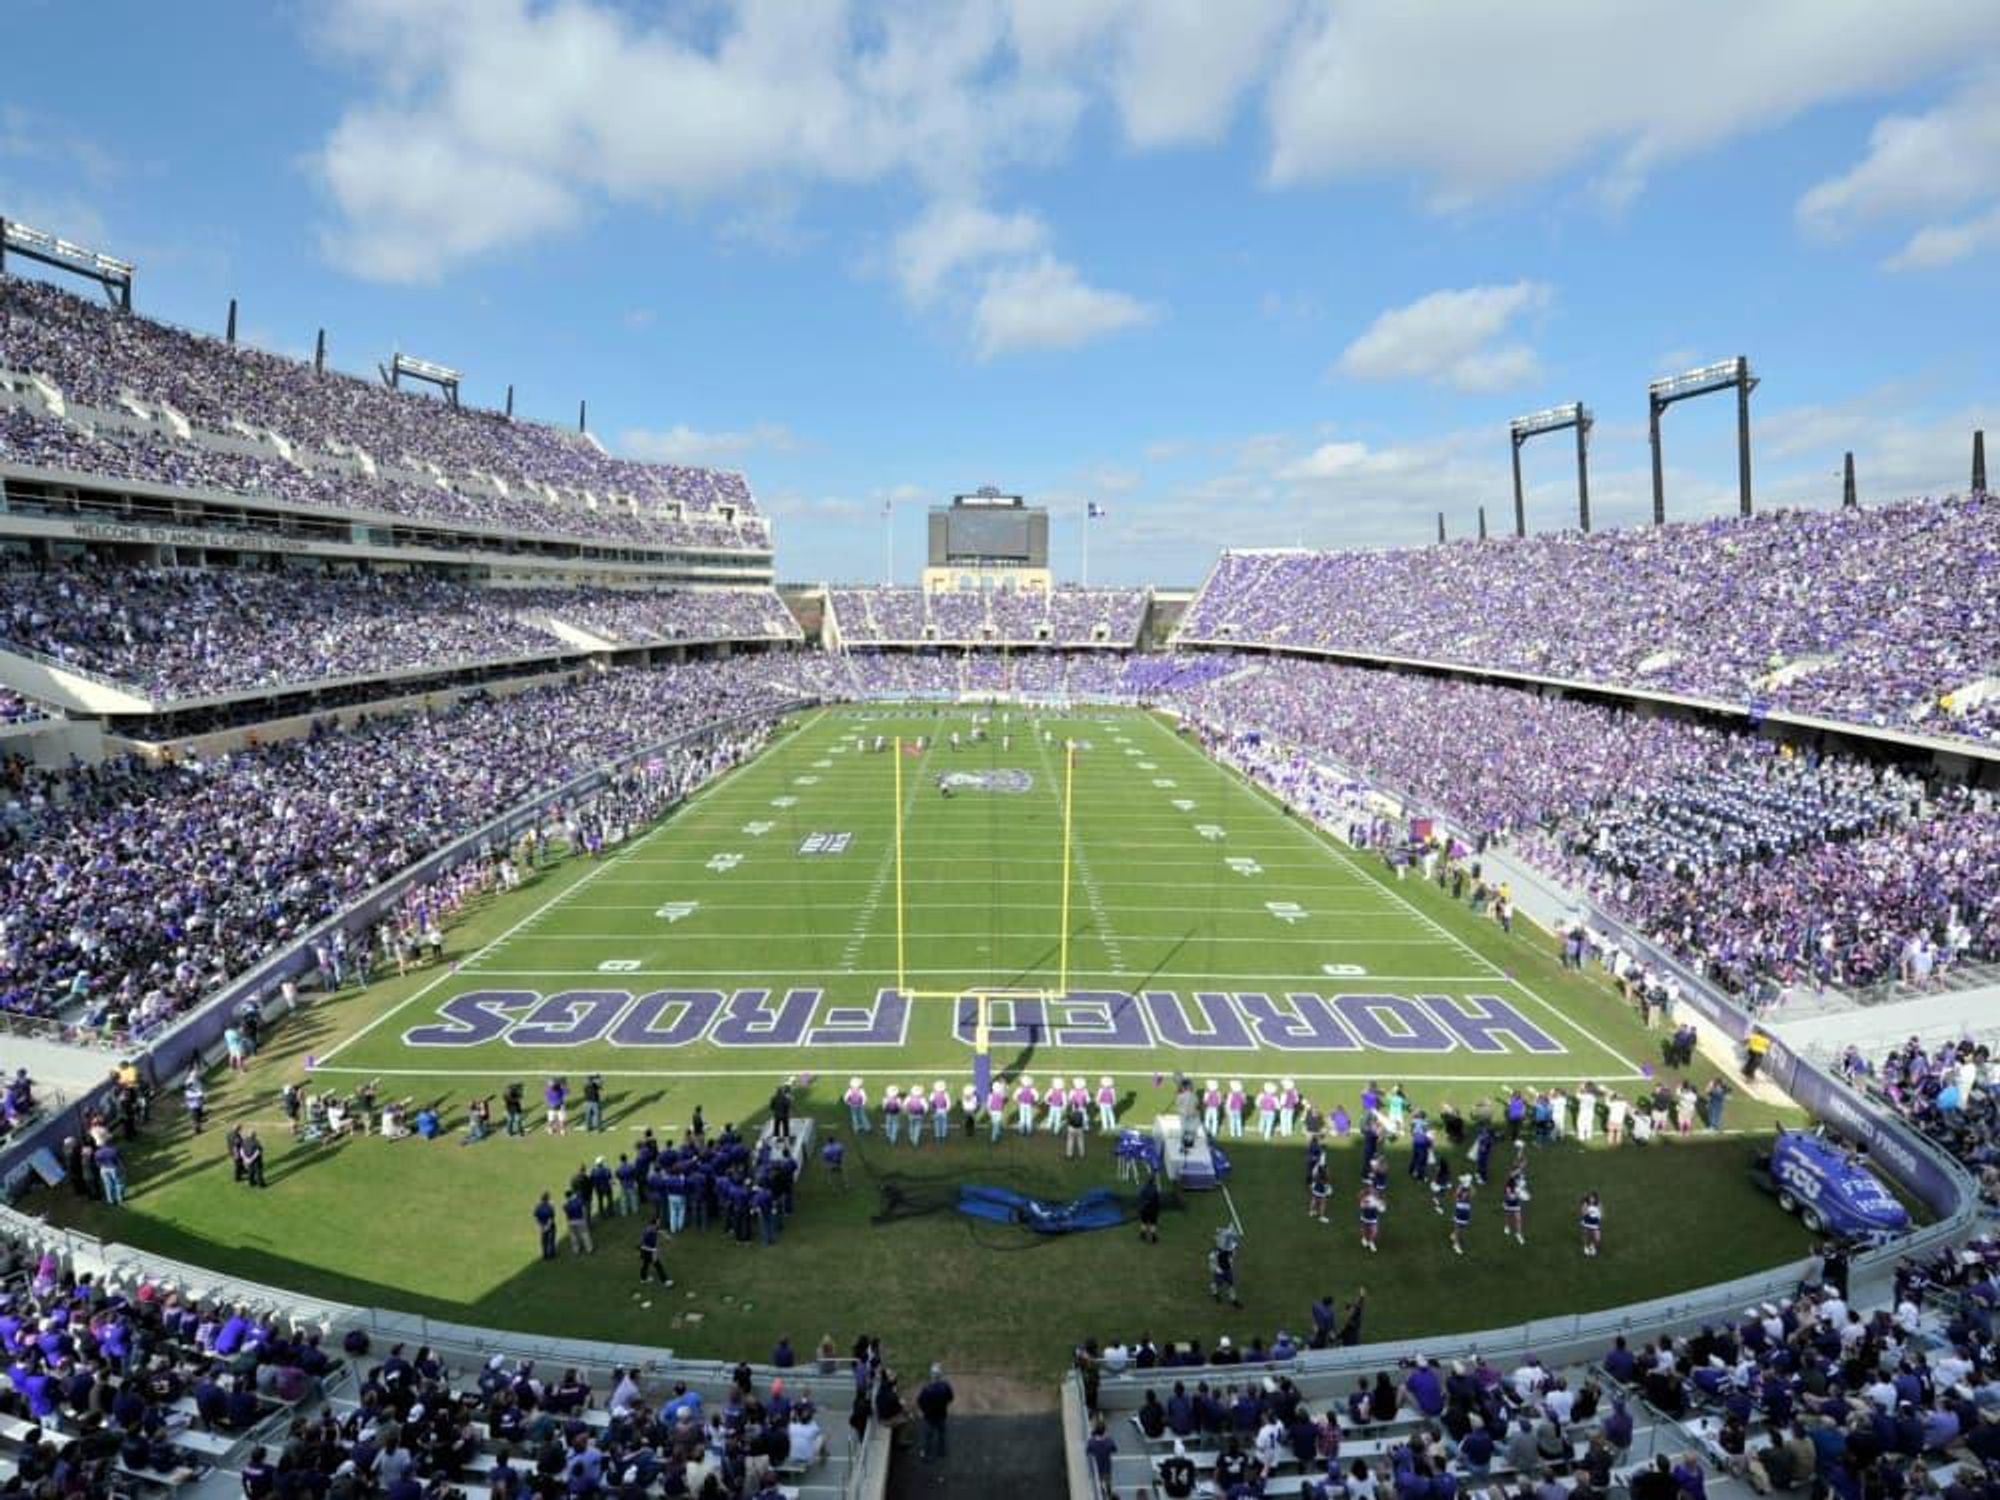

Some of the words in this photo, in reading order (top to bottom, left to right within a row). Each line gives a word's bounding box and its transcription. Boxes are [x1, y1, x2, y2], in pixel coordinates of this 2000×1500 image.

[73, 522, 142, 541] WELCOME
[401, 988, 914, 1048] FROGS
[952, 987, 1568, 1054] HORNED
[1780, 1160, 1822, 1199] TCU
